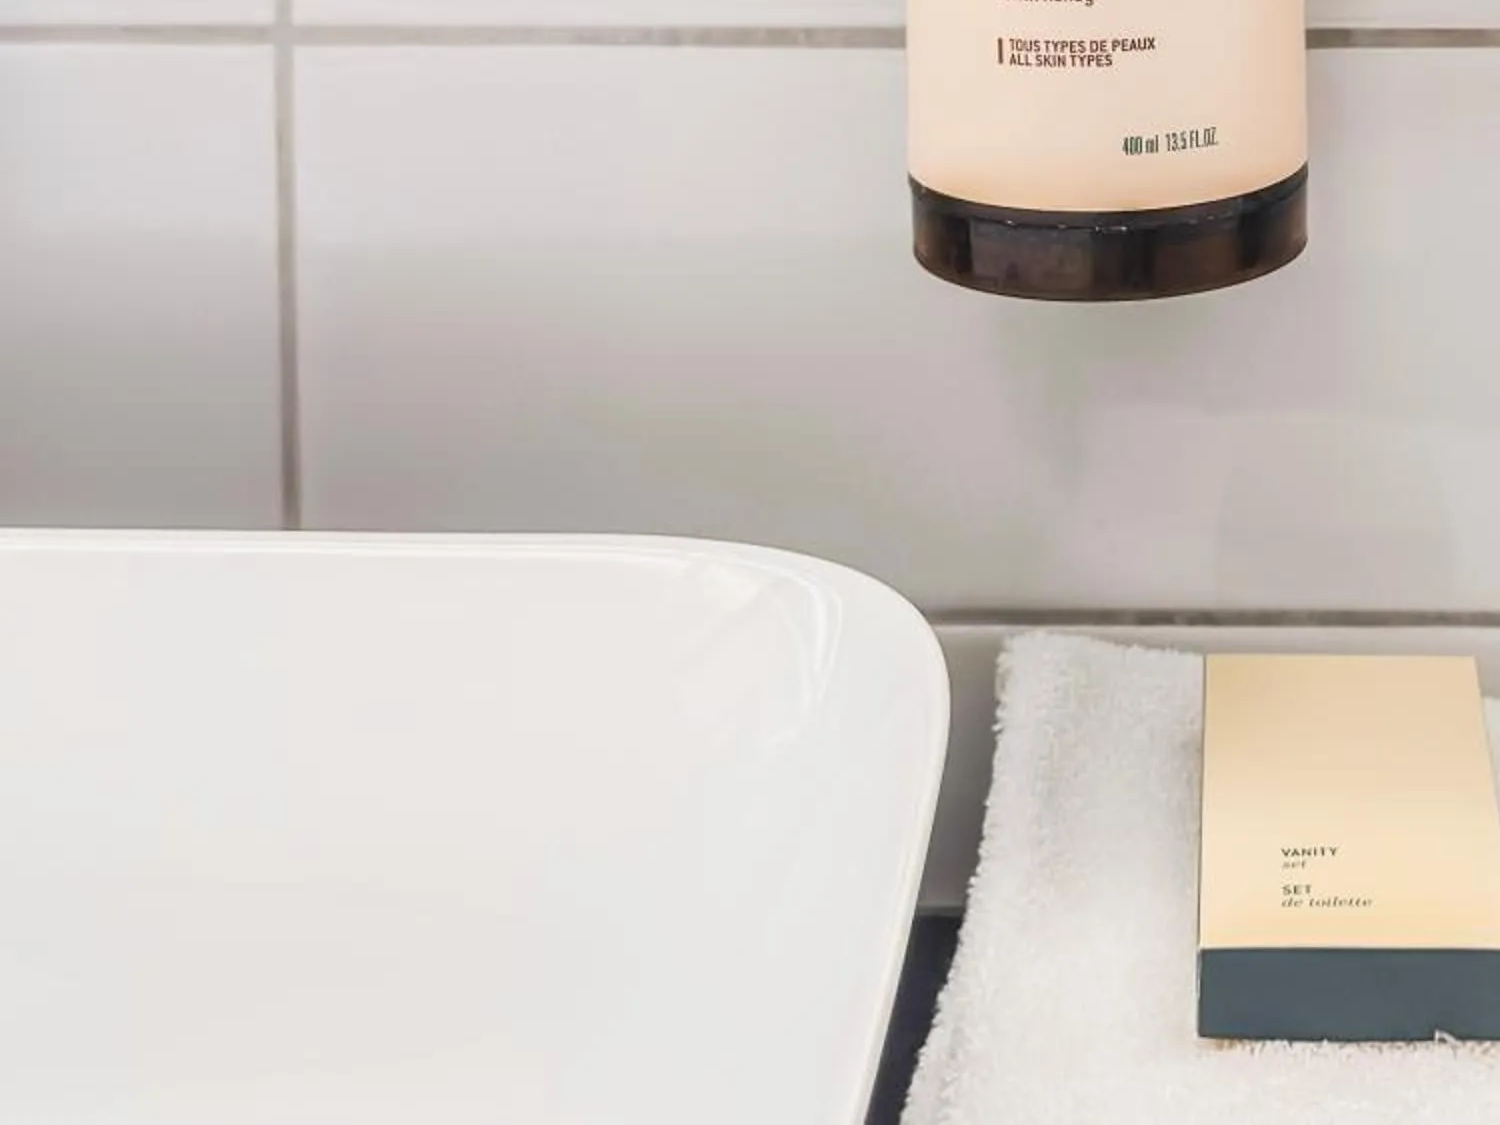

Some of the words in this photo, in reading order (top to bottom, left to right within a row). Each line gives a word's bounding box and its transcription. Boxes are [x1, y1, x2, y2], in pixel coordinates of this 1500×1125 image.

[1010, 39, 1041, 53] TOUS
[1044, 40, 1086, 54] TYPES
[1090, 39, 1108, 53] DE
[1112, 37, 1156, 51] PEAUX
[1009, 54, 1032, 66] ALL
[1034, 55, 1067, 67] SKIN
[1070, 54, 1113, 67] TYPES
[1122, 136, 1143, 155] 400
[1146, 135, 1159, 153] ml
[1166, 131, 1187, 151] 13.5
[1281, 847, 1338, 857] VANITY
[1282, 884, 1312, 895] SET
[1281, 898, 1303, 908] de
[1309, 897, 1373, 908] toilette
